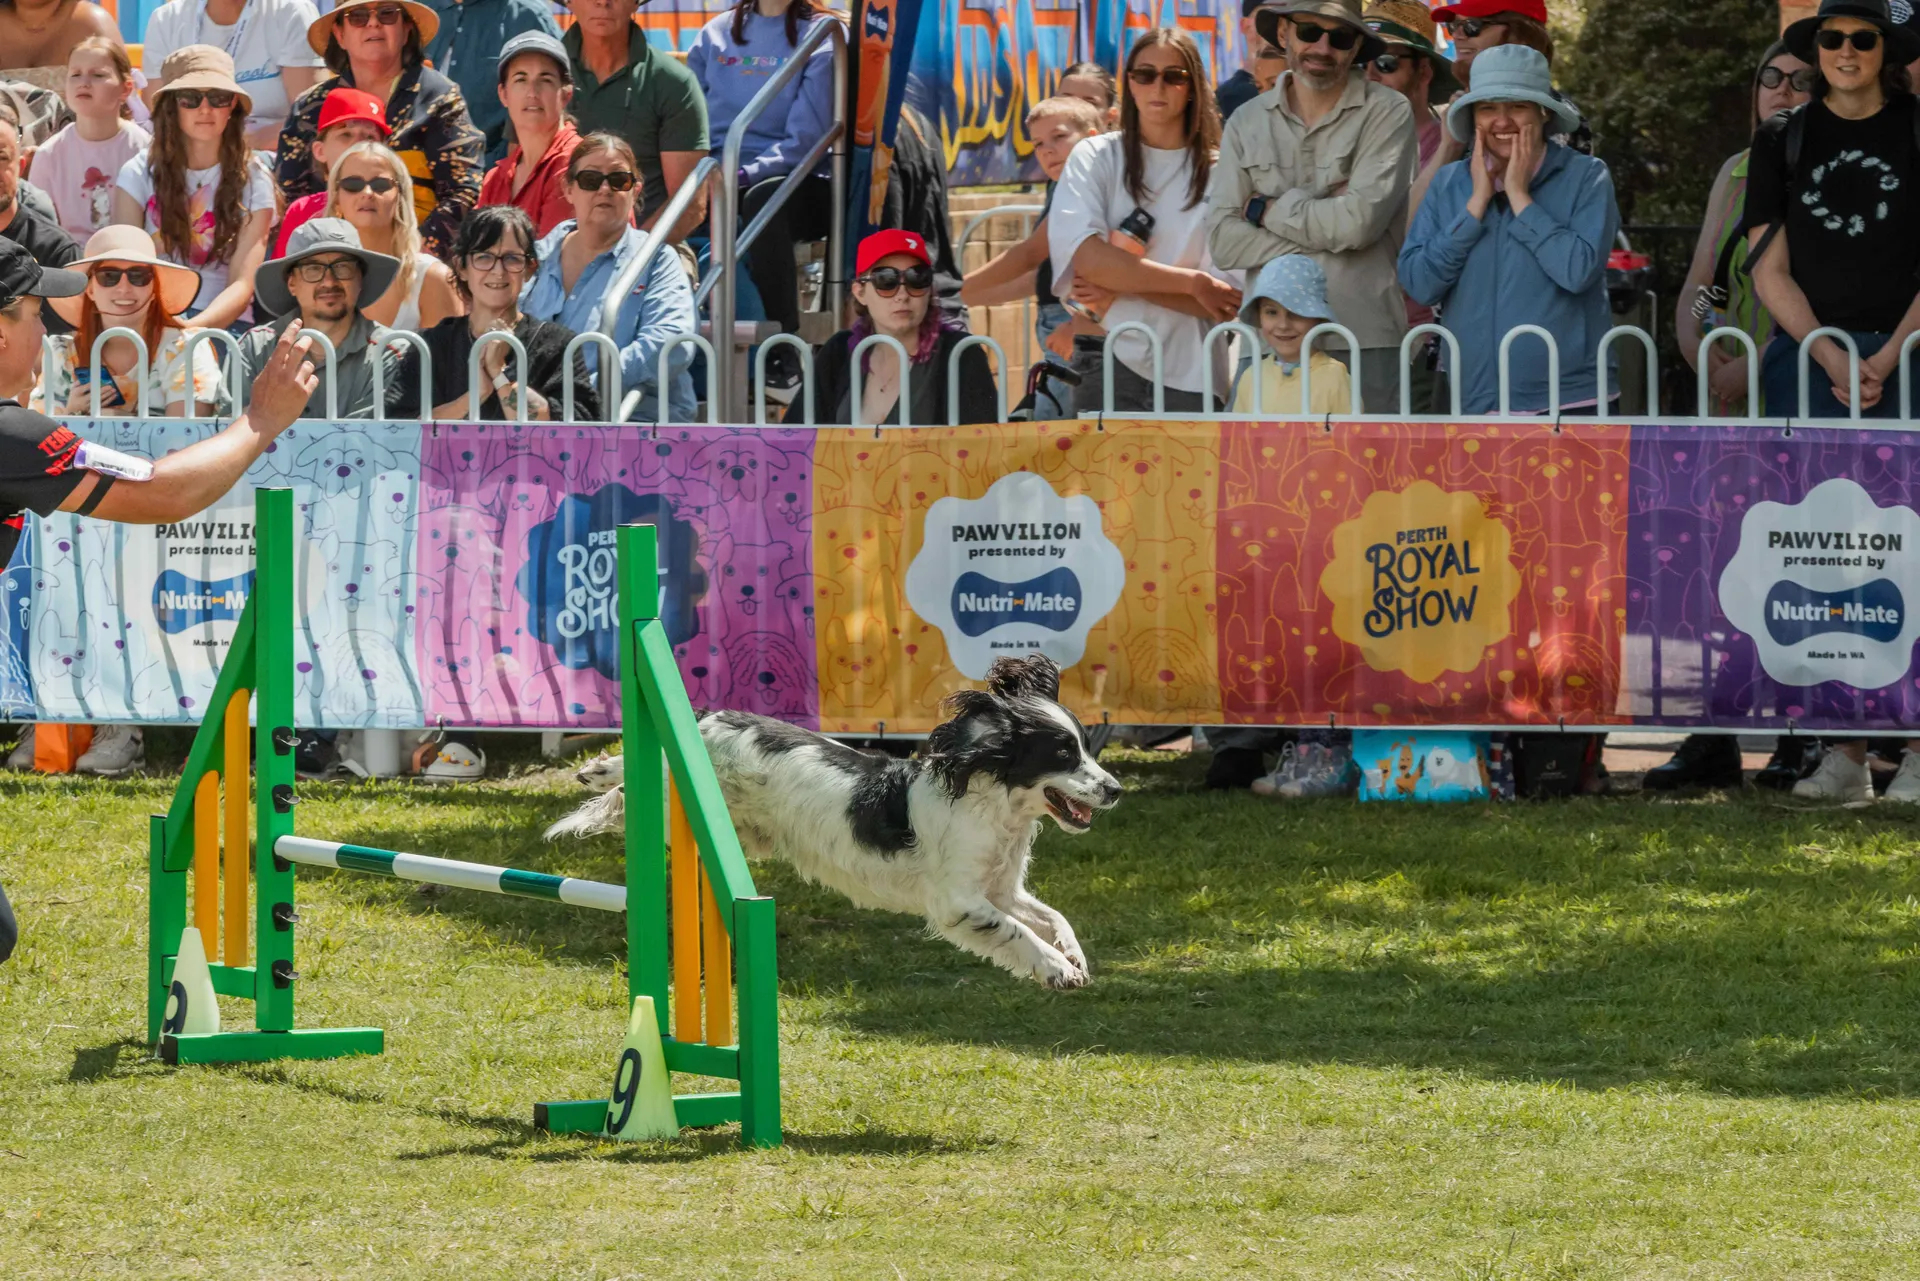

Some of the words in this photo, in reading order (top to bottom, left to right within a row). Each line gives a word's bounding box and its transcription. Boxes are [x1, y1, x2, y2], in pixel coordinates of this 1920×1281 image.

[155, 522, 256, 540] PAWVILI
[588, 529, 617, 547] PER
[952, 522, 1081, 542] PAWVILION
[1396, 525, 1448, 545] PERTH
[1768, 531, 1902, 551] PAWVILION
[169, 545, 244, 557] presented
[248, 545, 257, 556] b
[968, 545, 1046, 560] presented
[1049, 545, 1066, 558] by
[1365, 540, 1480, 598] ROYAL
[1783, 555, 1862, 568] presented
[1867, 556, 1885, 570] by
[159, 589, 249, 610] Nutri-M
[1364, 585, 1478, 638] SHOW
[193, 639, 218, 647] Made
[221, 639, 230, 647] in
[990, 641, 1014, 649] Made
[1016, 640, 1025, 649] in
[1027, 641, 1040, 649] WA
[1807, 651, 1835, 659] Made
[1838, 651, 1847, 659] in
[1850, 651, 1865, 660] WA
[607, 1048, 642, 1135] 9
